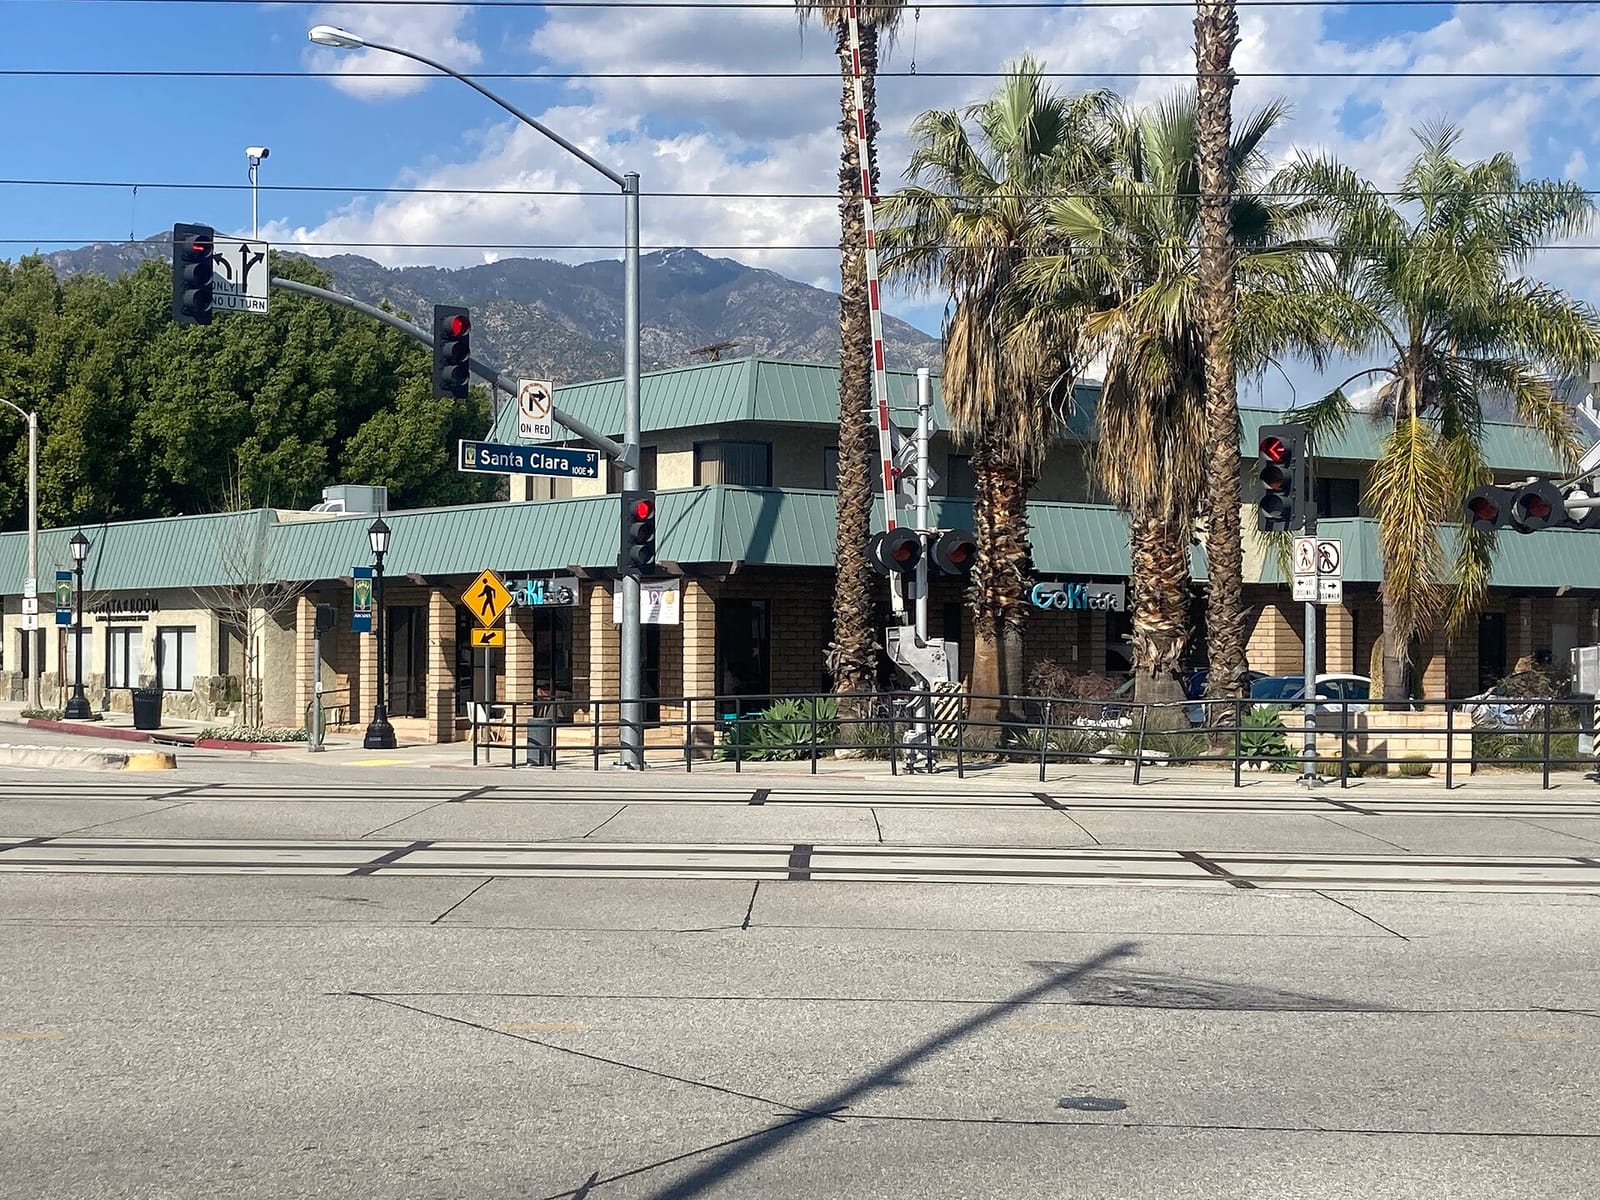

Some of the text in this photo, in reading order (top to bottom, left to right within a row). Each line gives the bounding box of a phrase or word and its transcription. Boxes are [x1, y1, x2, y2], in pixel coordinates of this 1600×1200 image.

[211, 281, 235, 292] ONLY
[212, 297, 265, 310] NO U TURN
[520, 423, 550, 435] ON RED
[480, 449, 569, 470] Santa Clara
[586, 453, 595, 462] ST
[572, 466, 587, 475] 100E
[130, 597, 160, 613] ROOM
